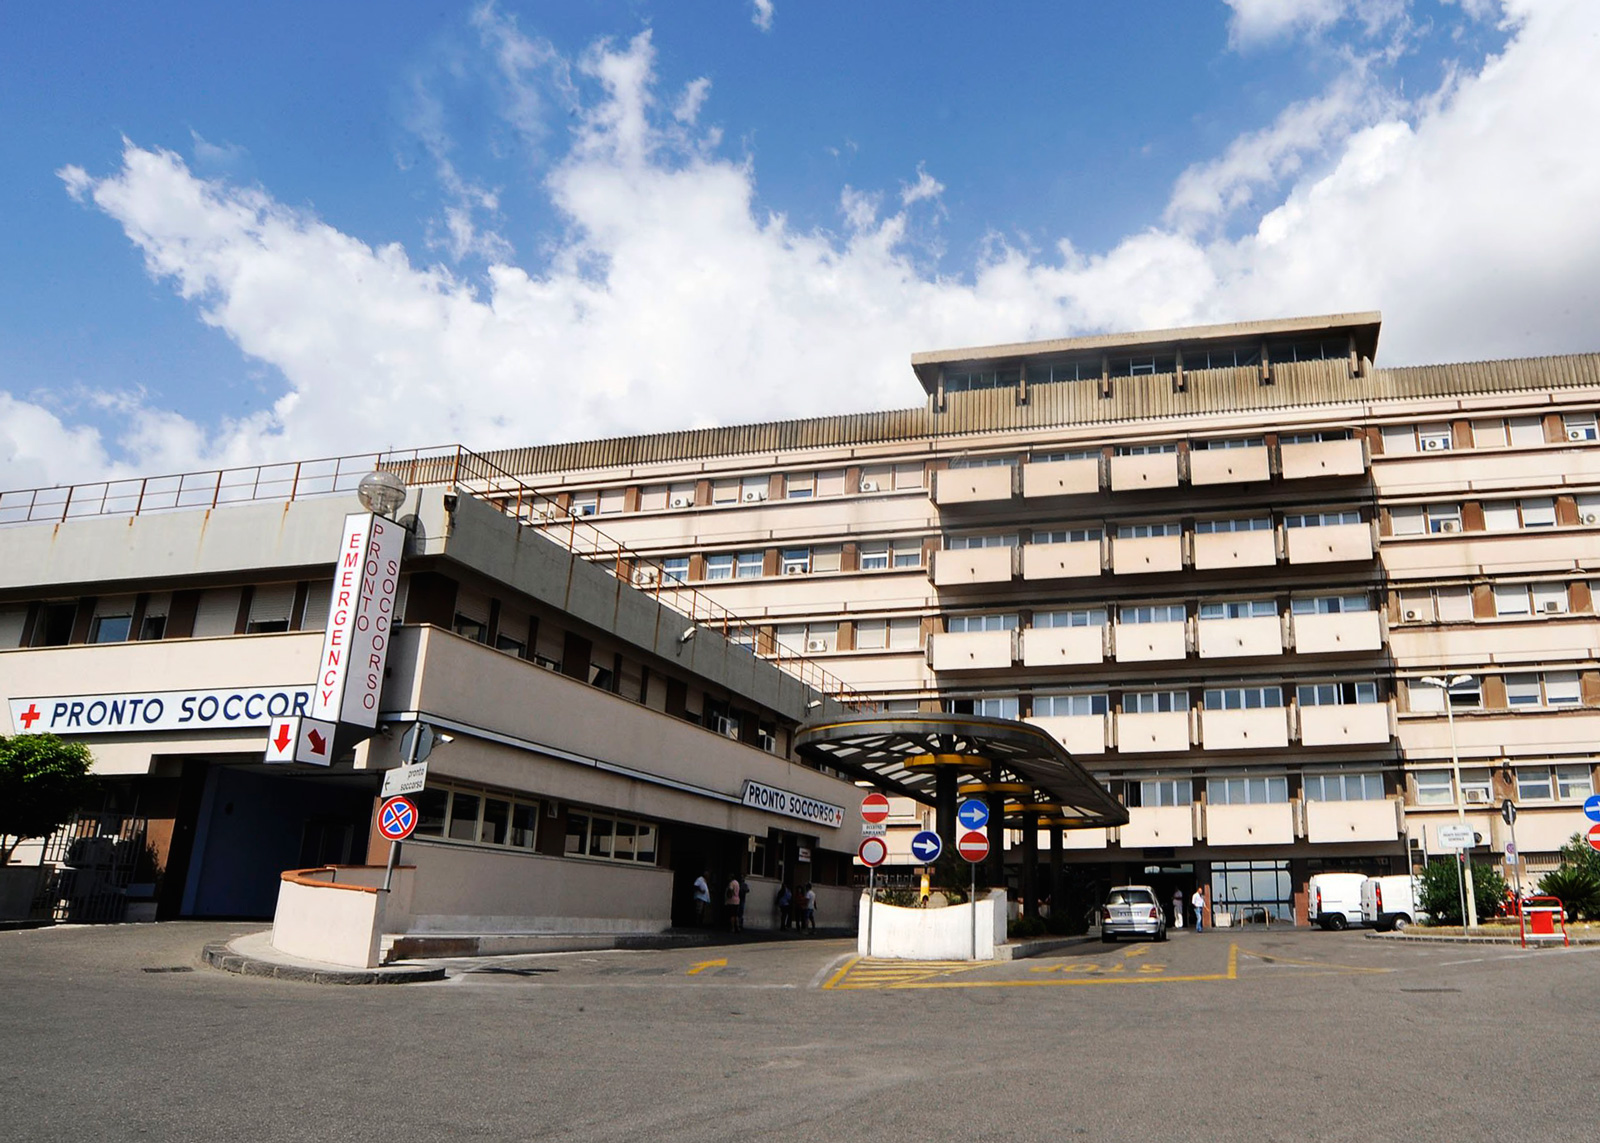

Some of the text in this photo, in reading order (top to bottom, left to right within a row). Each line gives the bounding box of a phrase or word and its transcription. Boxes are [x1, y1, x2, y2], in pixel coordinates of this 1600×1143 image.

[357, 523, 384, 632] PRONTO
[322, 533, 361, 707] EMERGENCY
[363, 560, 397, 710] SOCCORSO
[50, 698, 164, 728] PRONTO
[400, 780, 422, 791] soccorso
[408, 768, 424, 779] pronto
[748, 784, 834, 823] PRONTO SOCCORSO
